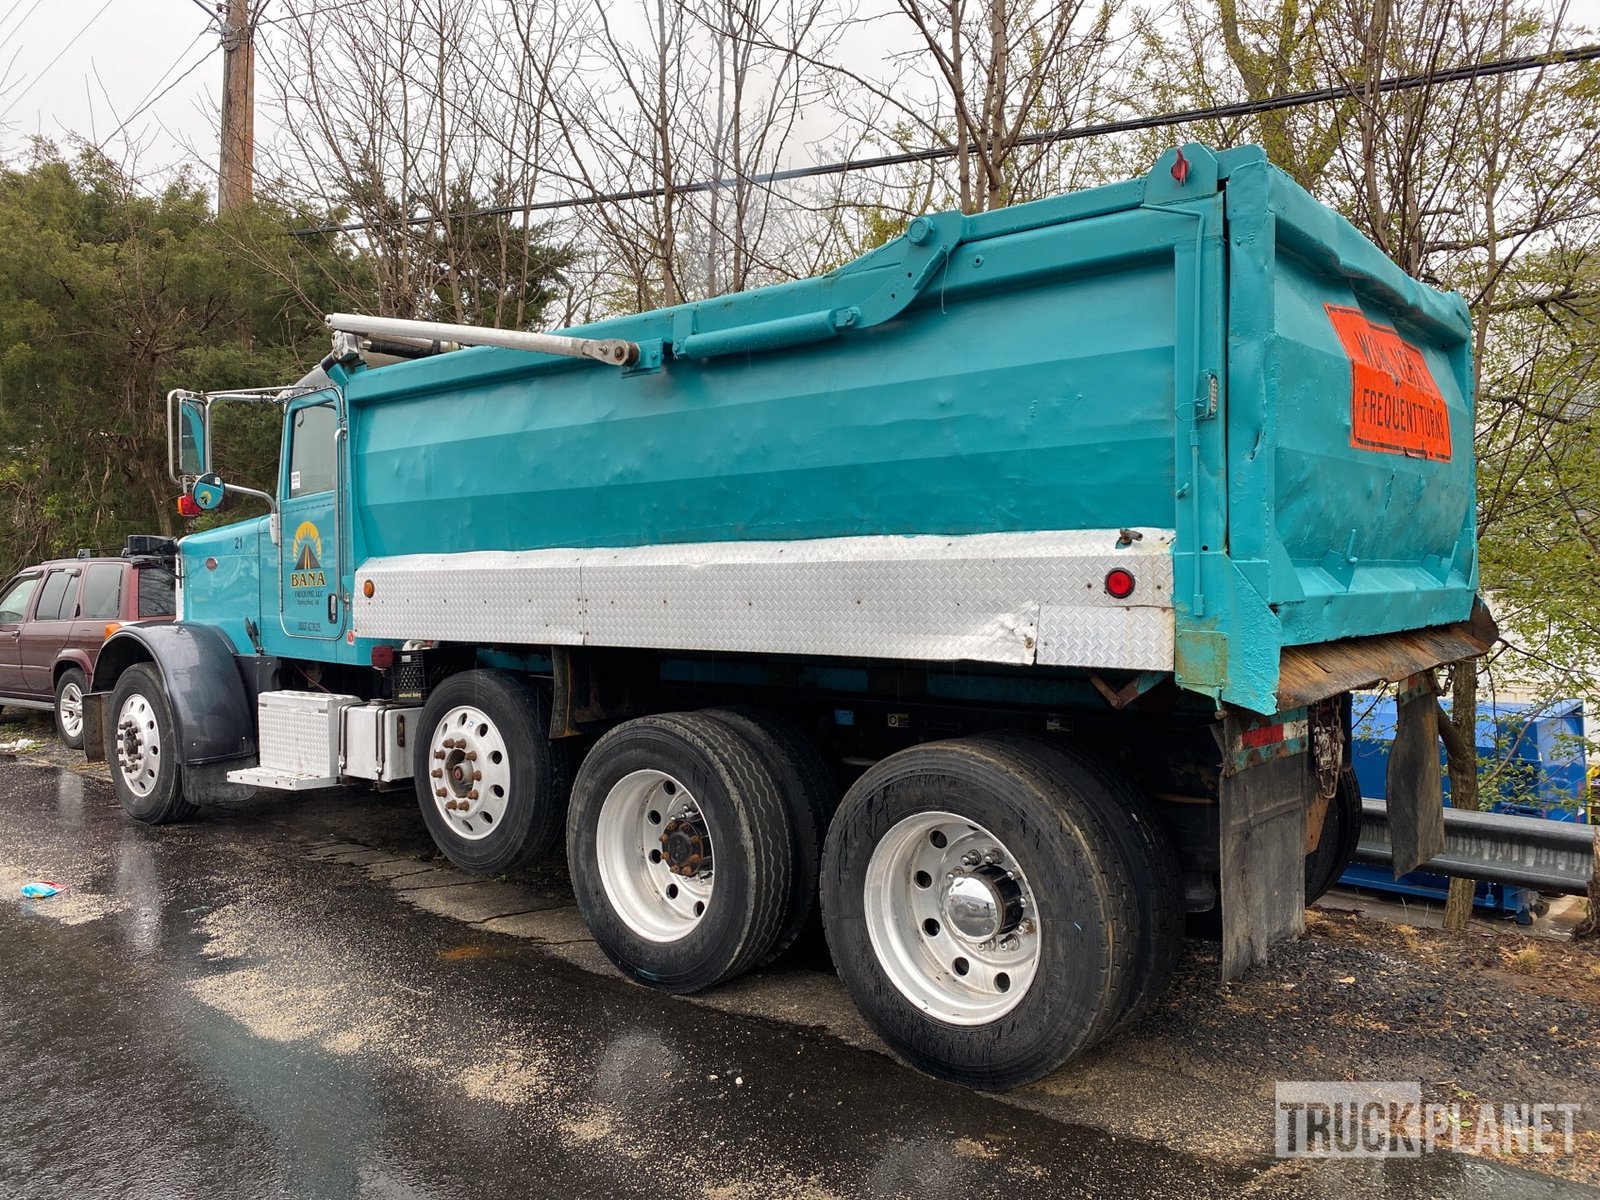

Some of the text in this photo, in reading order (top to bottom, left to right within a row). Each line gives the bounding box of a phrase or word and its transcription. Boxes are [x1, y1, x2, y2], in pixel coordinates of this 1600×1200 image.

[1362, 388, 1445, 441] FREQUENT TURNS
[234, 537, 243, 549] 21
[291, 572, 326, 587] BANA
